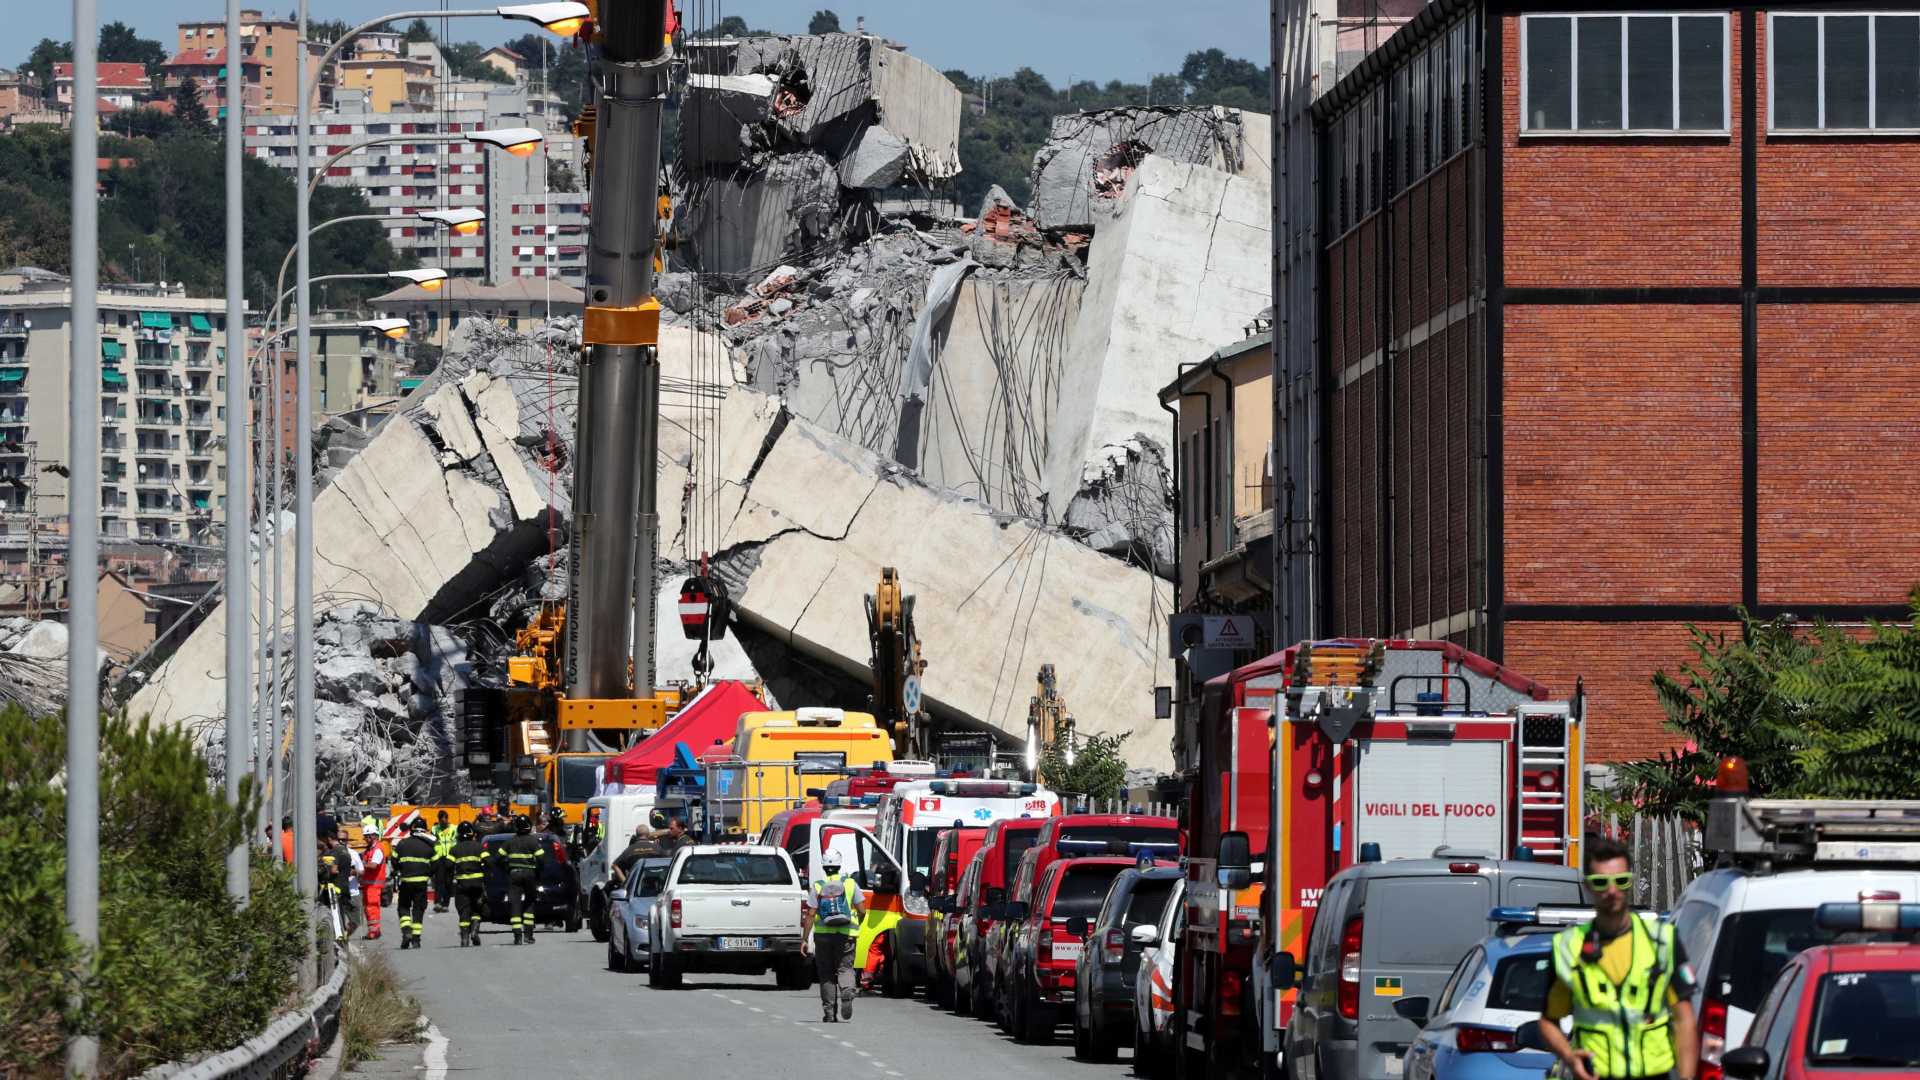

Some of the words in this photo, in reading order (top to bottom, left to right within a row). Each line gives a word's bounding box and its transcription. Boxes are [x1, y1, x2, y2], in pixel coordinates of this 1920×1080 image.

[572, 553, 580, 576] 900
[570, 583, 579, 643] MOMENT
[568, 646, 578, 685] LOAD
[1032, 800, 1046, 808] 118
[1365, 803, 1406, 816] VIGILI
[1411, 803, 1440, 817] DEL
[1444, 804, 1496, 817] FUOCO
